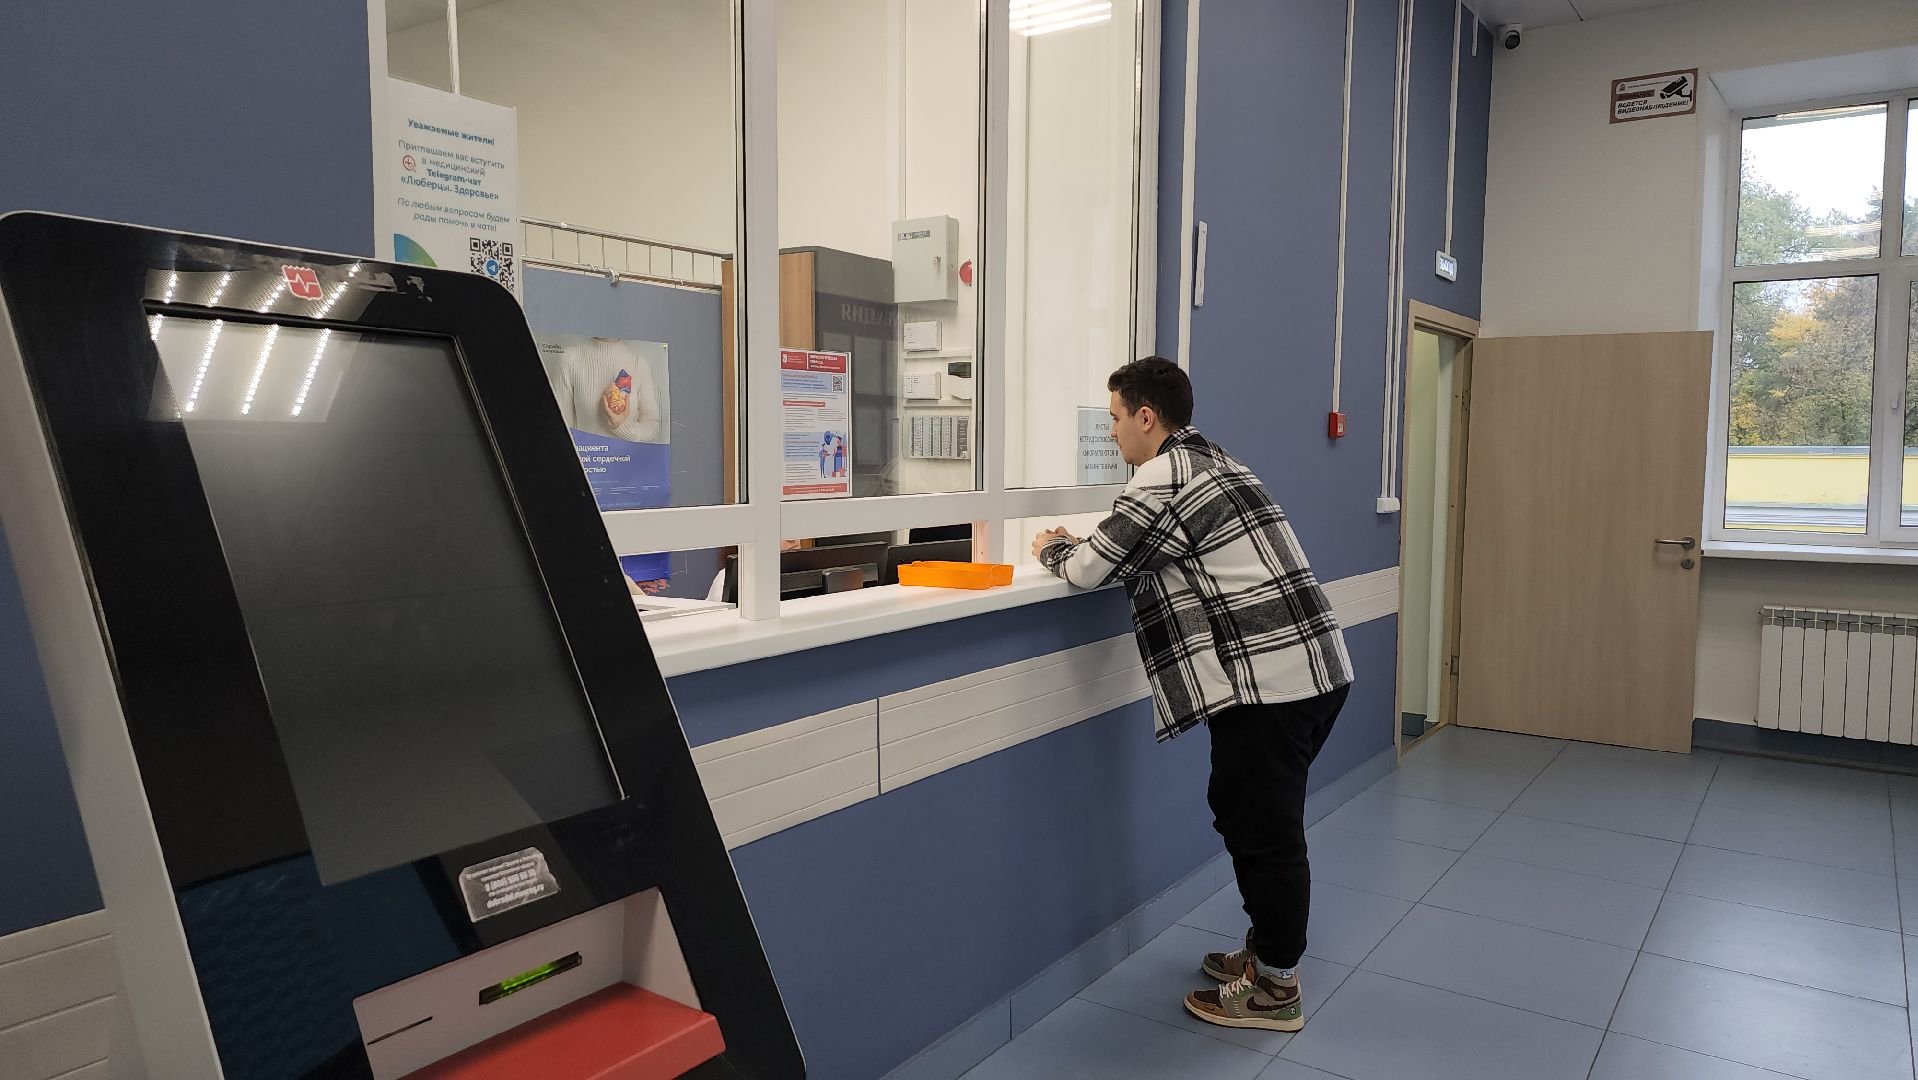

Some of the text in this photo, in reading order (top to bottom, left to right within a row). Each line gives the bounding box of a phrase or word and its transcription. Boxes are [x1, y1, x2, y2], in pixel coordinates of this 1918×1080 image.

[1617, 99, 1648, 109] ВЕДЕТСЯ
[407, 118, 495, 146] Уважаемые жители!
[398, 139, 505, 169] Приглашаем вас вступить
[421, 157, 486, 176] в медицинский
[426, 168, 482, 186] Telegram-чат
[400, 175, 499, 200] «Люберцы. Здоровье»
[397, 197, 410, 207] По
[410, 200, 443, 212] любым
[486, 212, 510, 224] будем
[413, 213, 497, 232] рады помочь в чате!
[592, 455, 631, 464] сердечной
